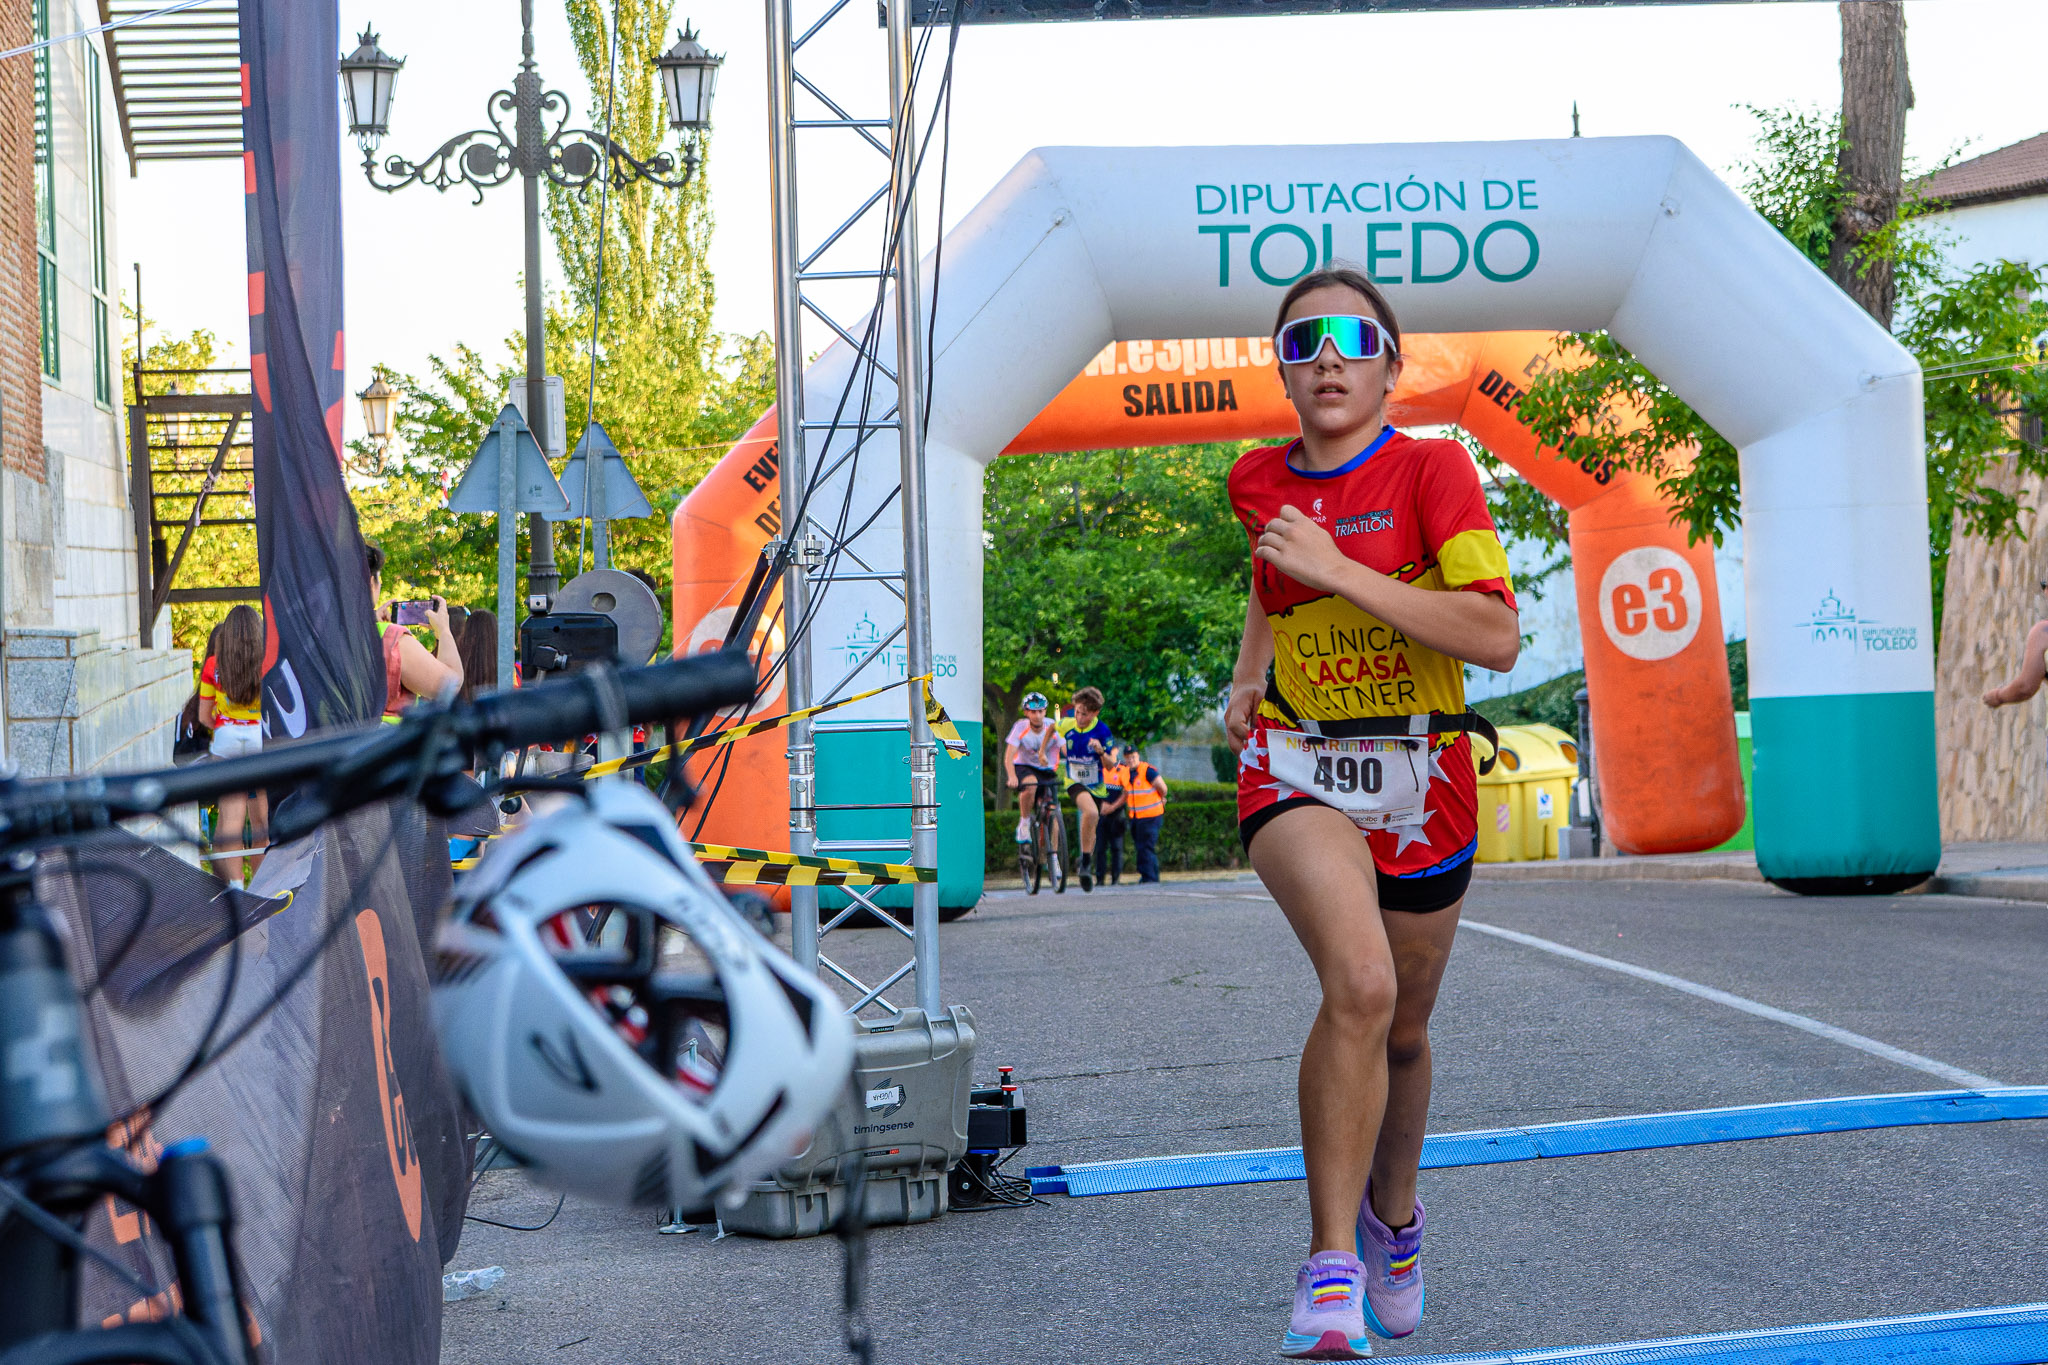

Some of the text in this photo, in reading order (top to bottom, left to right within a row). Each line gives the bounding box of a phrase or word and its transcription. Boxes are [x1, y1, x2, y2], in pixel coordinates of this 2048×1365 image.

[1196, 174, 1539, 215] DIPUTACIÓN DE
[1123, 379, 1238, 417] SALIDA
[1612, 567, 1688, 635] e3
[1297, 624, 1409, 658] CLÍNICA
[1864, 637, 1918, 651] TOLEDO
[1313, 756, 1383, 794] 490
[853, 1120, 915, 1134] timingsense
